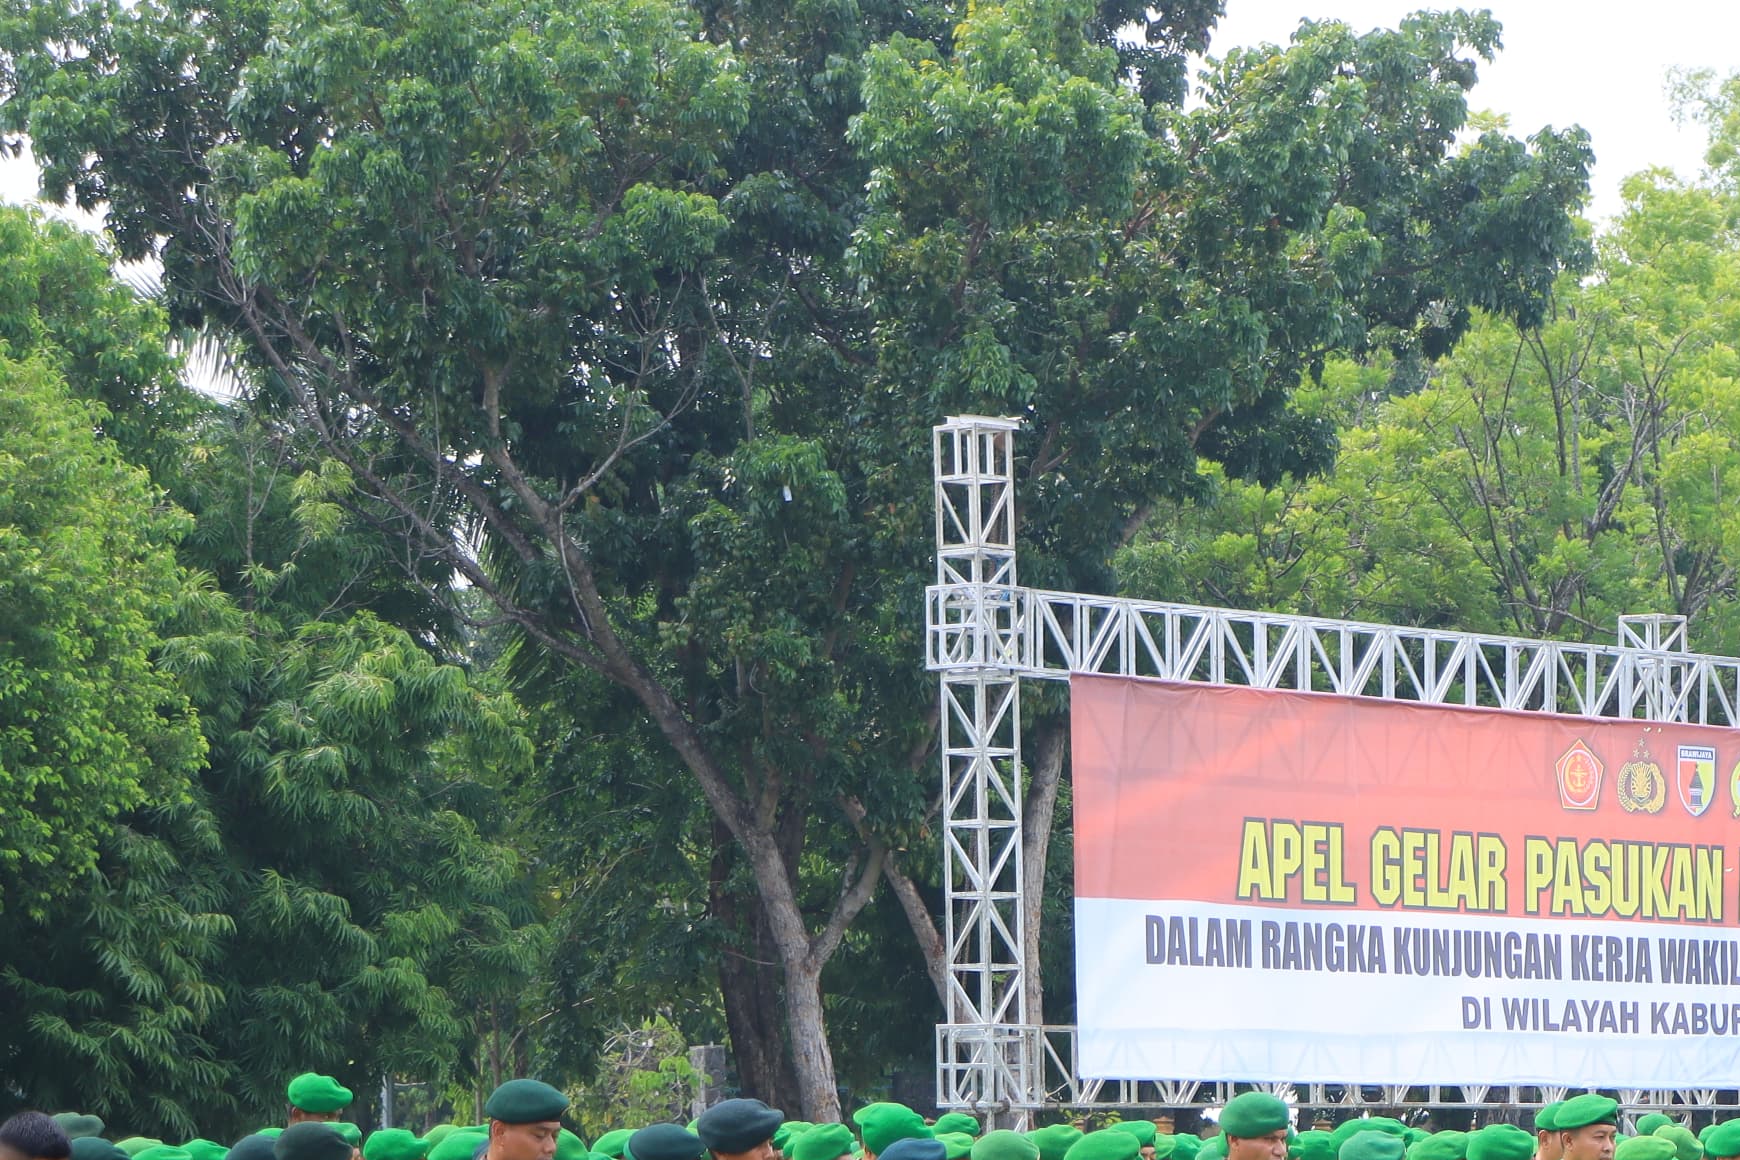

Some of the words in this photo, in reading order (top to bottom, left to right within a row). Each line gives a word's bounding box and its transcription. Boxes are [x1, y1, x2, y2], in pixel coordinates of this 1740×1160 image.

[1237, 817, 1357, 905] APEL
[1370, 826, 1507, 913] GELAR
[1524, 836, 1724, 922] PASUKAN
[1145, 915, 1252, 967] DALAM
[1261, 922, 1387, 973] RANGKA
[1394, 927, 1562, 980] KUNJUNGAN
[1571, 934, 1653, 985] KERJA
[1461, 996, 1492, 1030] DI
[1502, 998, 1639, 1034] WILAYAH
